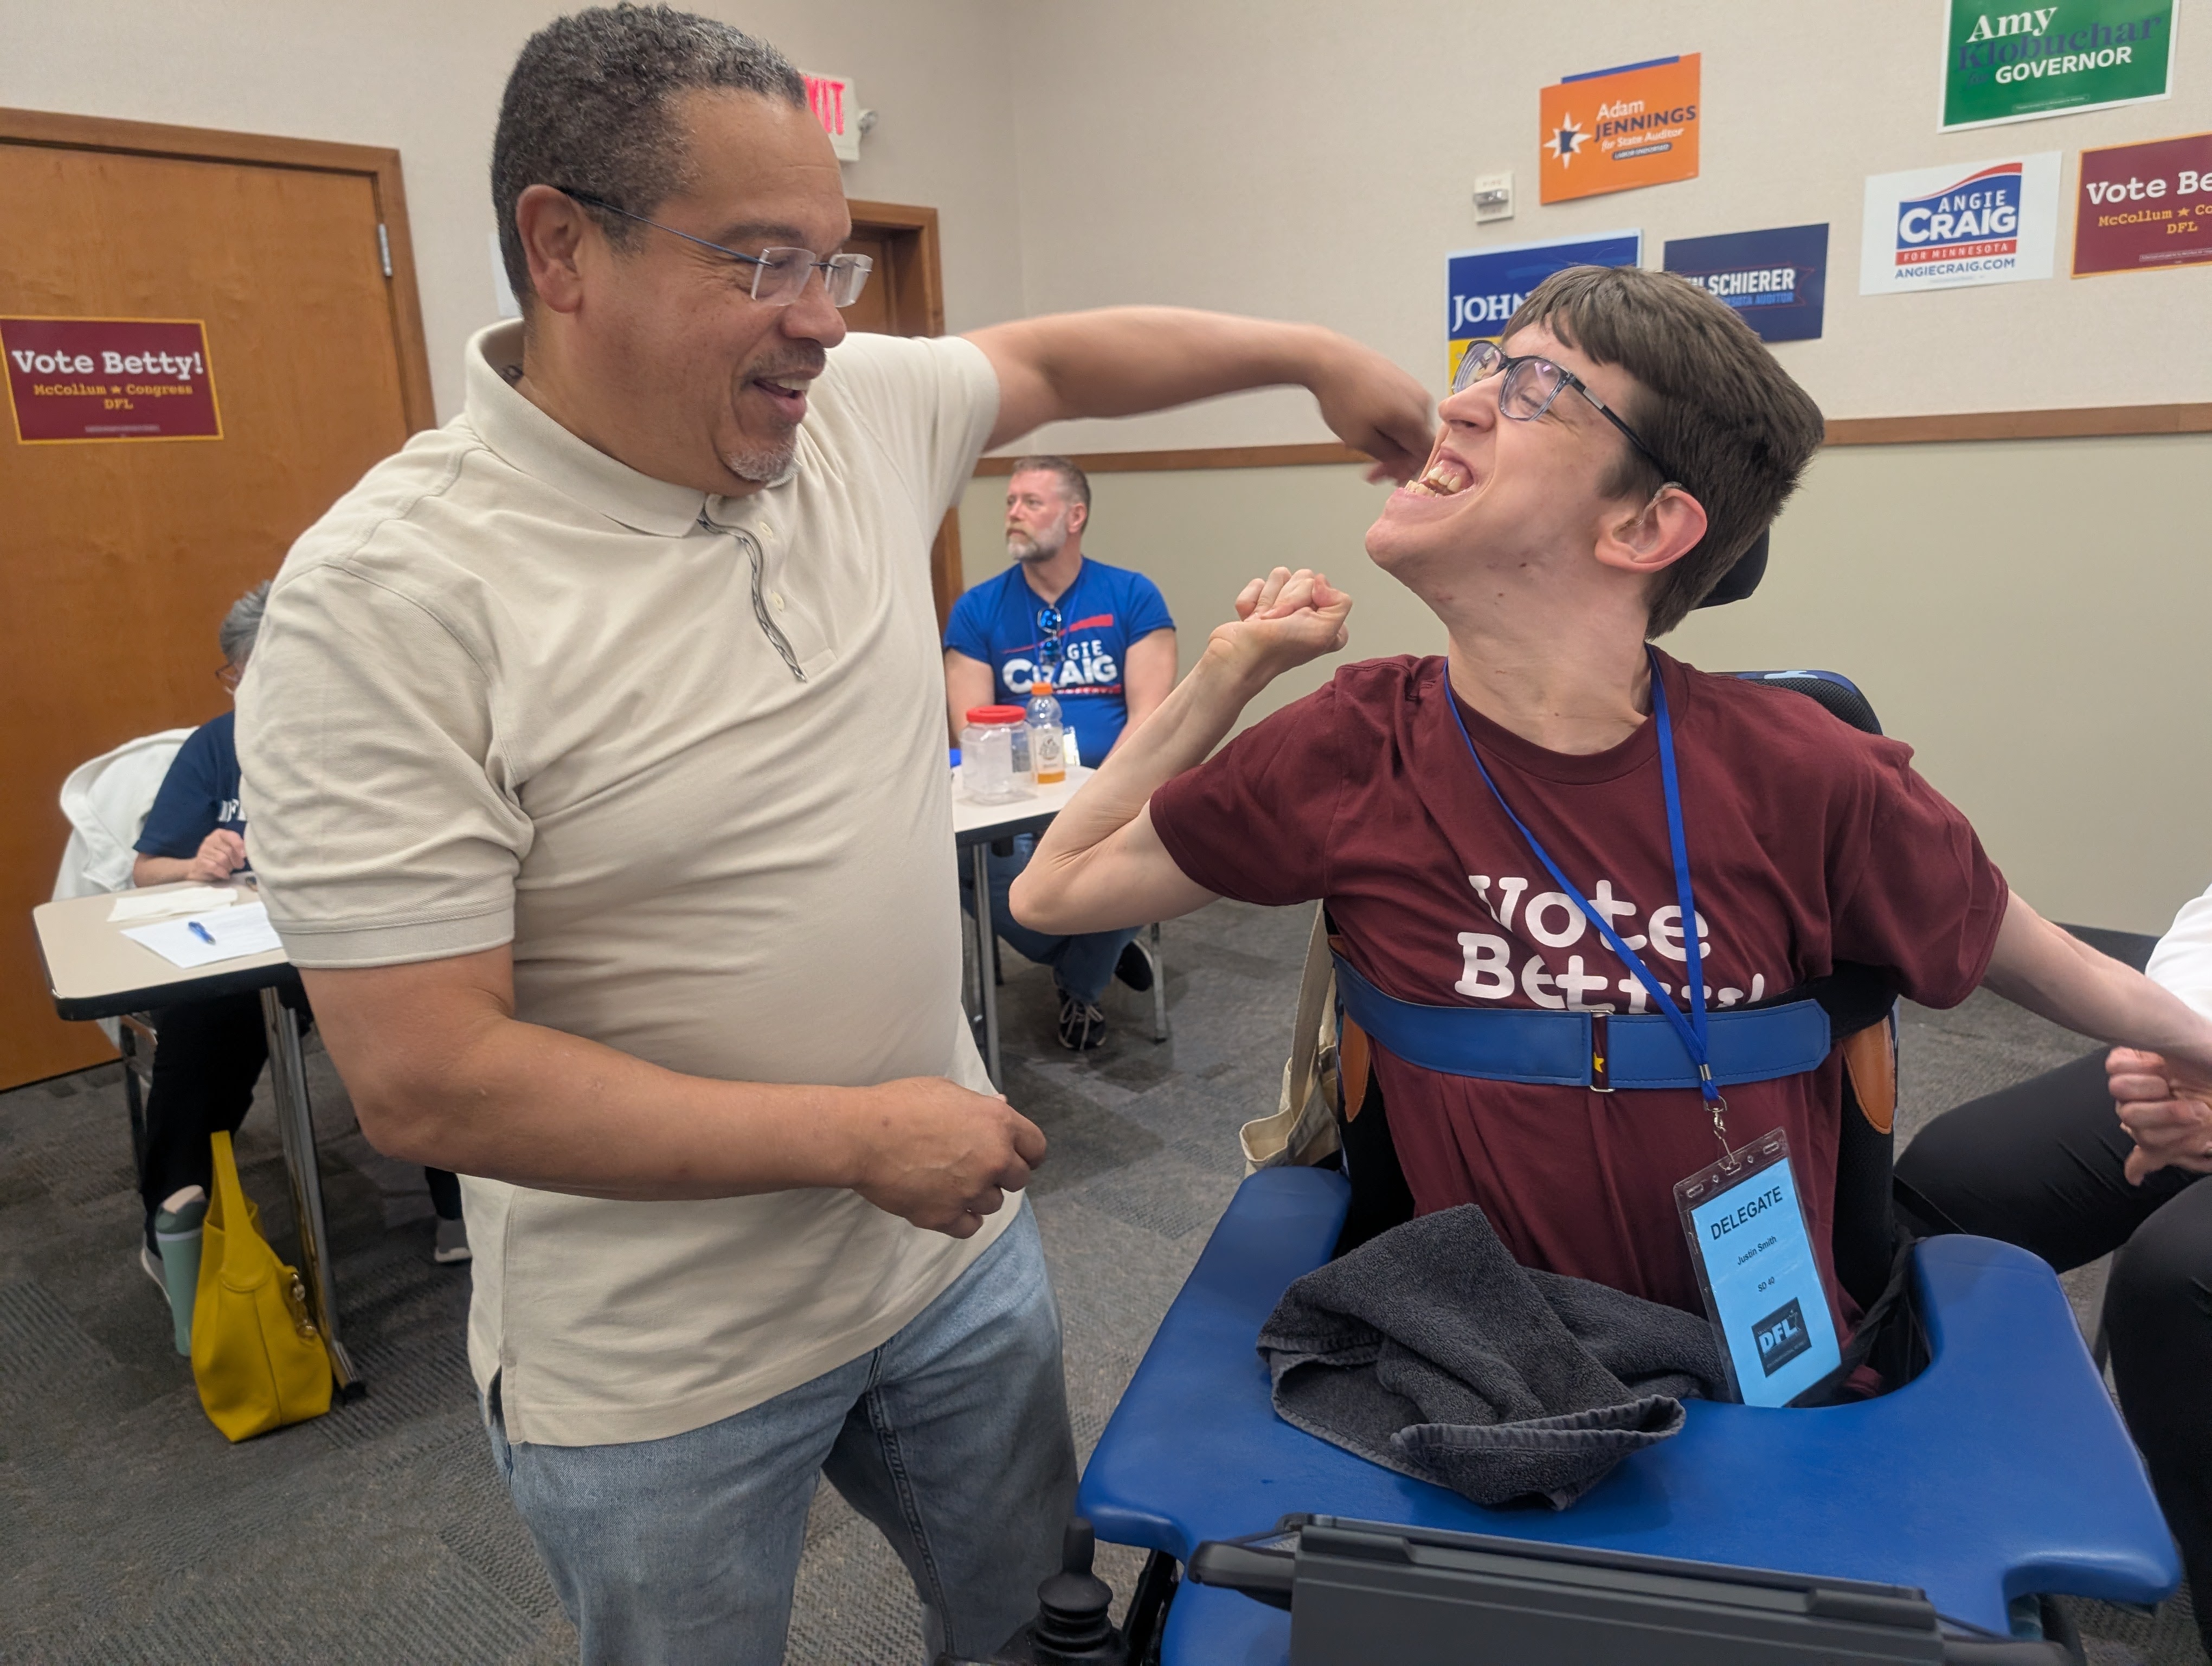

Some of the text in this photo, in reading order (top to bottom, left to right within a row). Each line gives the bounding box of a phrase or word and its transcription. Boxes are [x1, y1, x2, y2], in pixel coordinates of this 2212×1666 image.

[1966, 7, 2057, 43] Amy
[1958, 16, 2162, 71] Klobuchar
[1995, 46, 2132, 84] GOVERNOR
[803, 76, 845, 136] XIT
[1596, 100, 1645, 121] Adam
[1594, 105, 1696, 142] JENNINGS
[1617, 136, 1643, 147] State
[1644, 128, 1684, 142] Auditor
[1938, 189, 2007, 213] ANGIE
[2086, 176, 2168, 205] Vote
[1899, 206, 2017, 244] CRAIG
[2098, 209, 2173, 227] McCollum
[2166, 221, 2198, 234] DFL
[1904, 242, 2008, 262] FOR MINNESOTA
[1707, 268, 1796, 296] SCHIERER
[1895, 258, 2015, 280] ANGIECRAIG.COM
[11, 349, 203, 381] Vote Betty!
[34, 382, 194, 398] McCollum Congress
[104, 398, 133, 410] DFL
[1468, 875, 1711, 962] Vote
[1711, 1186, 1783, 1240] DELEGATE
[1737, 1235, 1777, 1266] Justin Smith
[1758, 1276, 1775, 1292] SD 40
[1759, 1318, 1798, 1355] DFL
